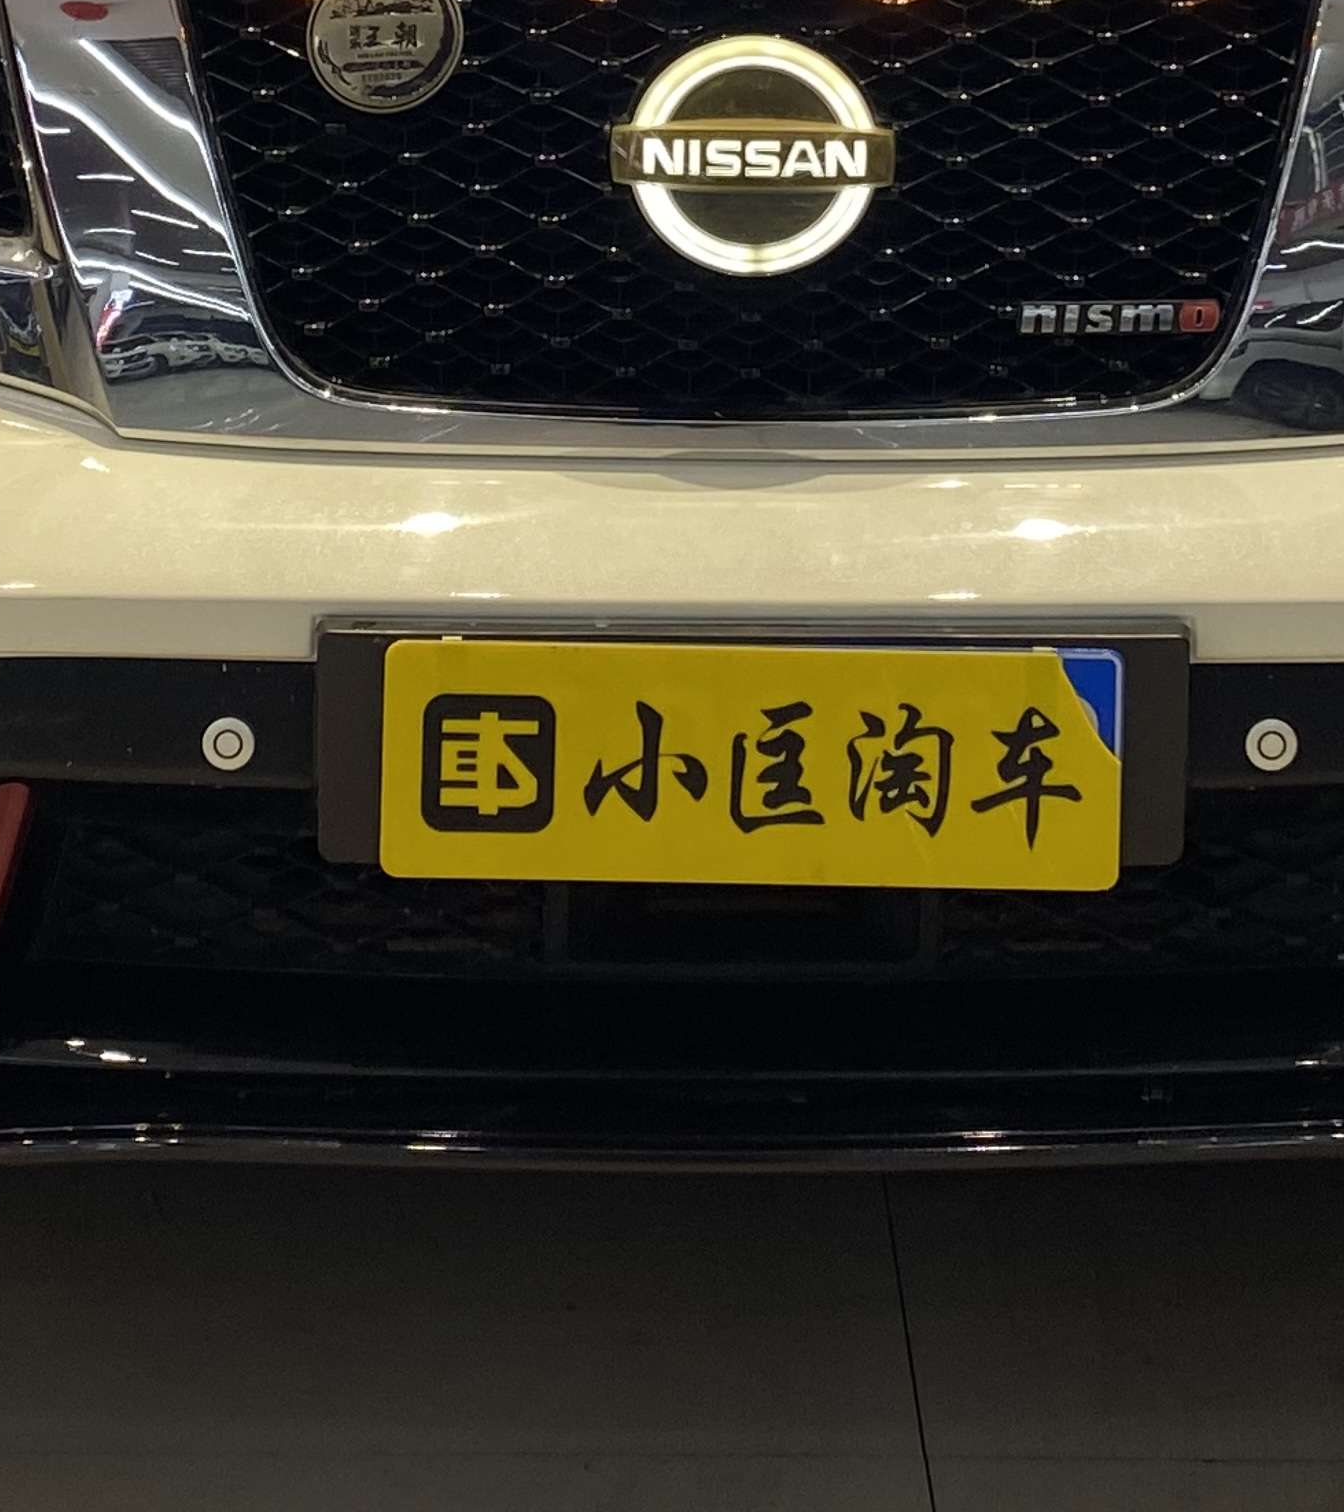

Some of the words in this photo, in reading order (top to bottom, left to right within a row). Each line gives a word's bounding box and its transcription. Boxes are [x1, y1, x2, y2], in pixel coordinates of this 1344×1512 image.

[642, 138, 867, 178] NISSAN
[583, 700, 1083, 851] 小匡淘车
